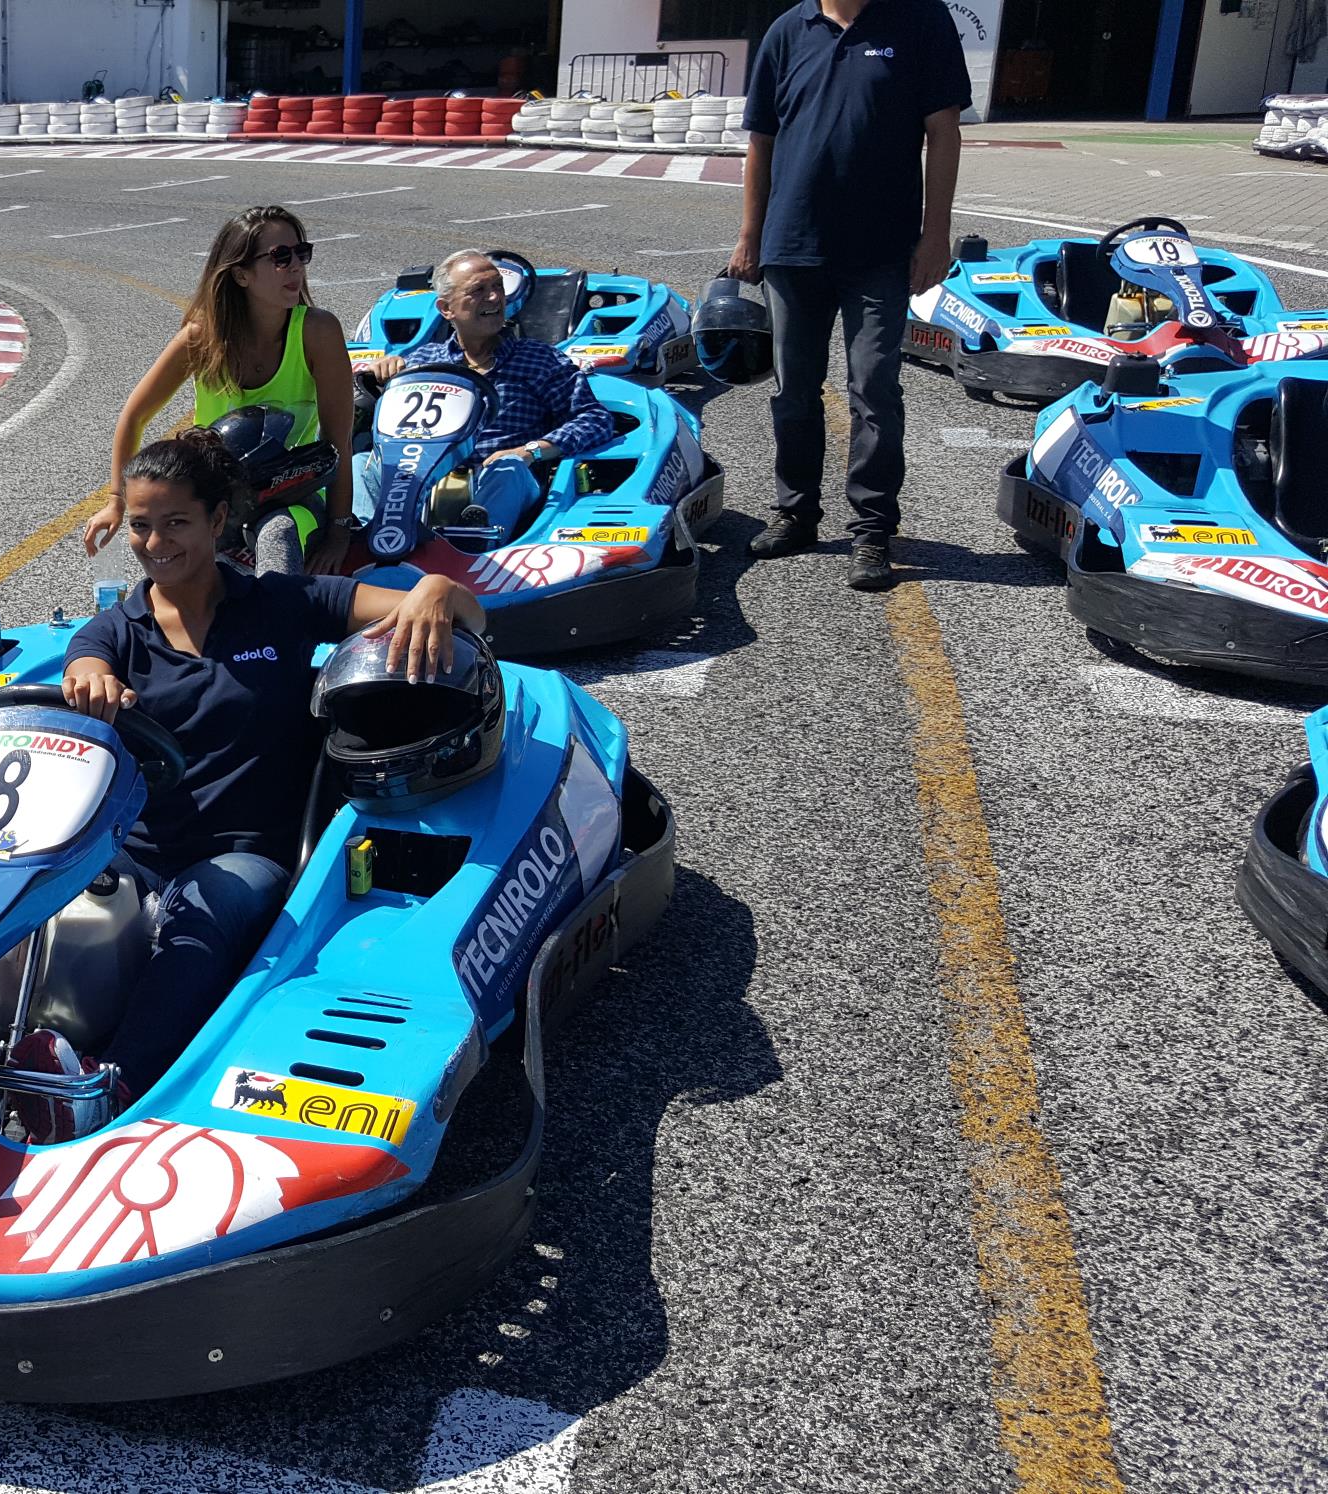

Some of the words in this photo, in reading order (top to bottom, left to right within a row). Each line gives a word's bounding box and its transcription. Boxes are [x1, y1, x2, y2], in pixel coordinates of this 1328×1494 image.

[1149, 241, 1180, 262] 19
[940, 293, 988, 335] TECNIROL
[1034, 326, 1068, 336] eni
[397, 391, 448, 429] 25
[381, 443, 423, 526] TECNIROLO
[591, 527, 641, 543] eni
[1192, 529, 1250, 545] eni
[1227, 560, 1328, 608] HURON
[458, 826, 567, 999] TECNIROLO
[495, 948, 529, 1001] ENGENHARIA
[299, 1095, 401, 1142] eni
